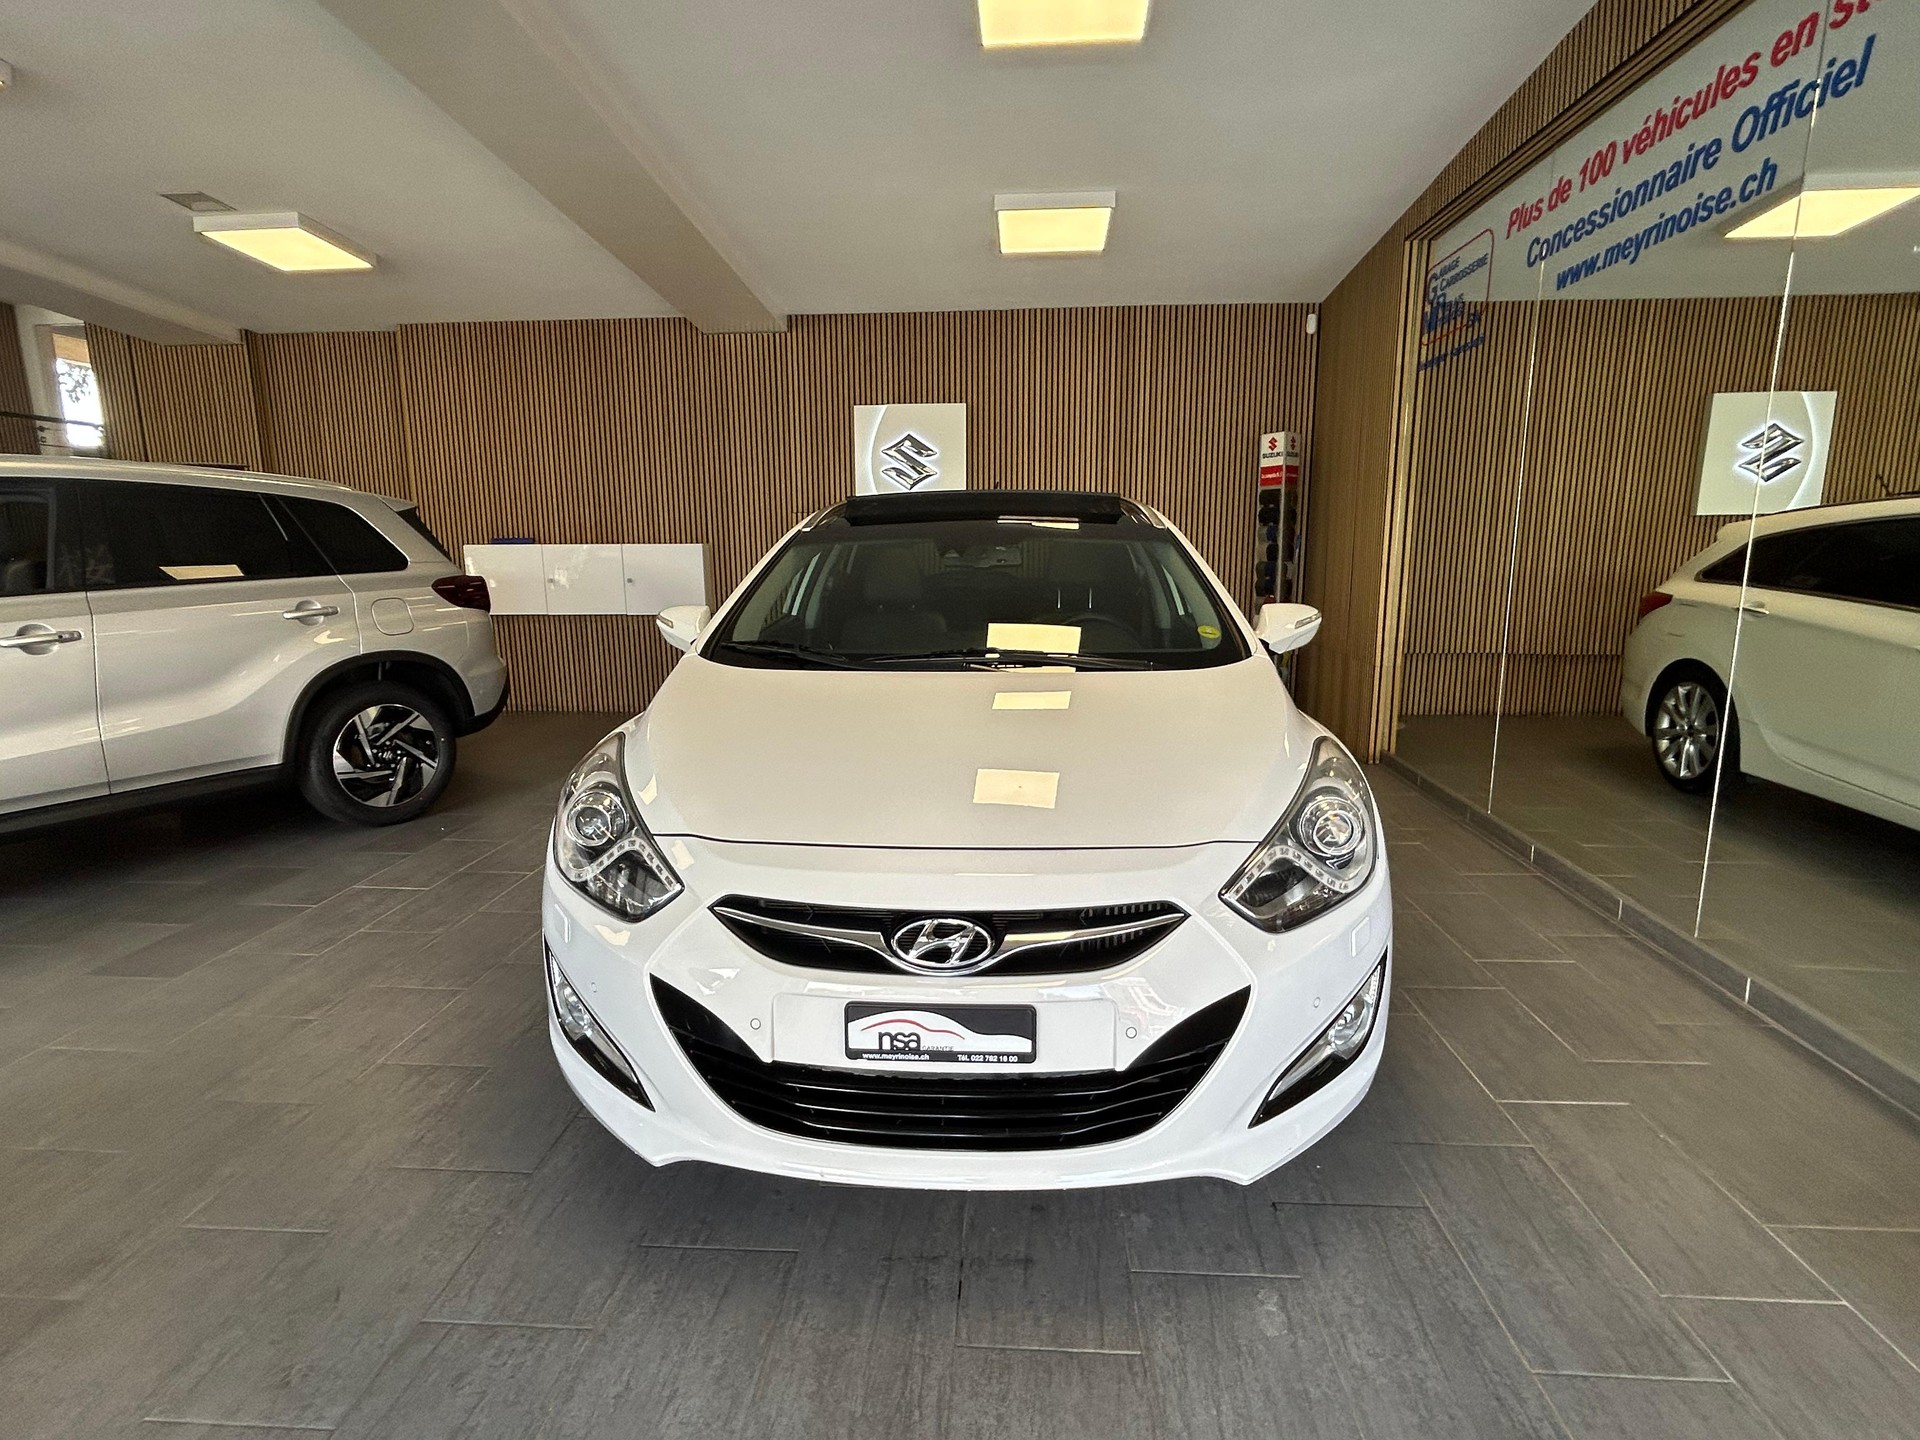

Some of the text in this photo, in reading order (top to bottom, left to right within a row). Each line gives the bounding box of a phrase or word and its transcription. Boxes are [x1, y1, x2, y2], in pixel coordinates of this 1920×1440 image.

[1506, 199, 1543, 240] Plus
[1548, 177, 1572, 212] de
[1579, 141, 1618, 193] 100
[1622, 51, 1762, 165] véhicules
[1770, 11, 1821, 68] en
[1527, 33, 1877, 268] Concessionnaire Officiel
[1556, 157, 1778, 291] www.meyrinoise.ch
[878, 1031, 921, 1051] nsa
